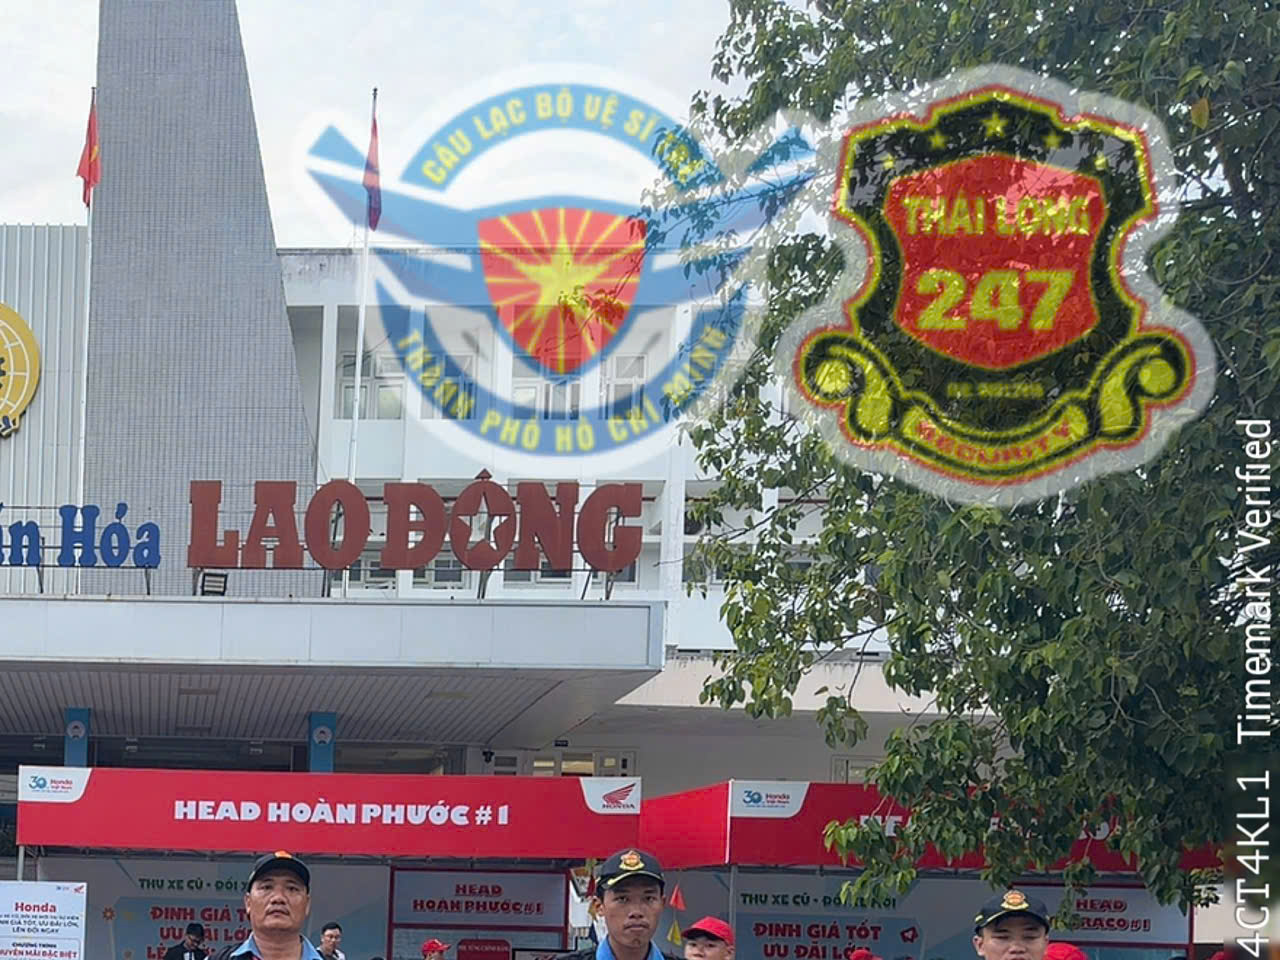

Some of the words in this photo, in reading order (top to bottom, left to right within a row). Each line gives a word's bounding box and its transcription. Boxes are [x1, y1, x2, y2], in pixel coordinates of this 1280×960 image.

[186, 479, 371, 570] LAO
[57, 502, 161, 568] Hóa
[173, 800, 262, 821] HEAD
[267, 797, 356, 825] HOÀN
[361, 800, 470, 826] PHƯỚC
[138, 877, 165, 889] THU
[167, 879, 184, 890] XE
[455, 883, 503, 897] HEAD
[740, 892, 769, 905] THU
[771, 893, 791, 905] XE
[1075, 897, 1128, 912] HEAD
[14, 902, 57, 913] Honda
[200, 904, 232, 922] GIÁ
[806, 920, 841, 940] GIÁ
[846, 919, 882, 941] TỐT
